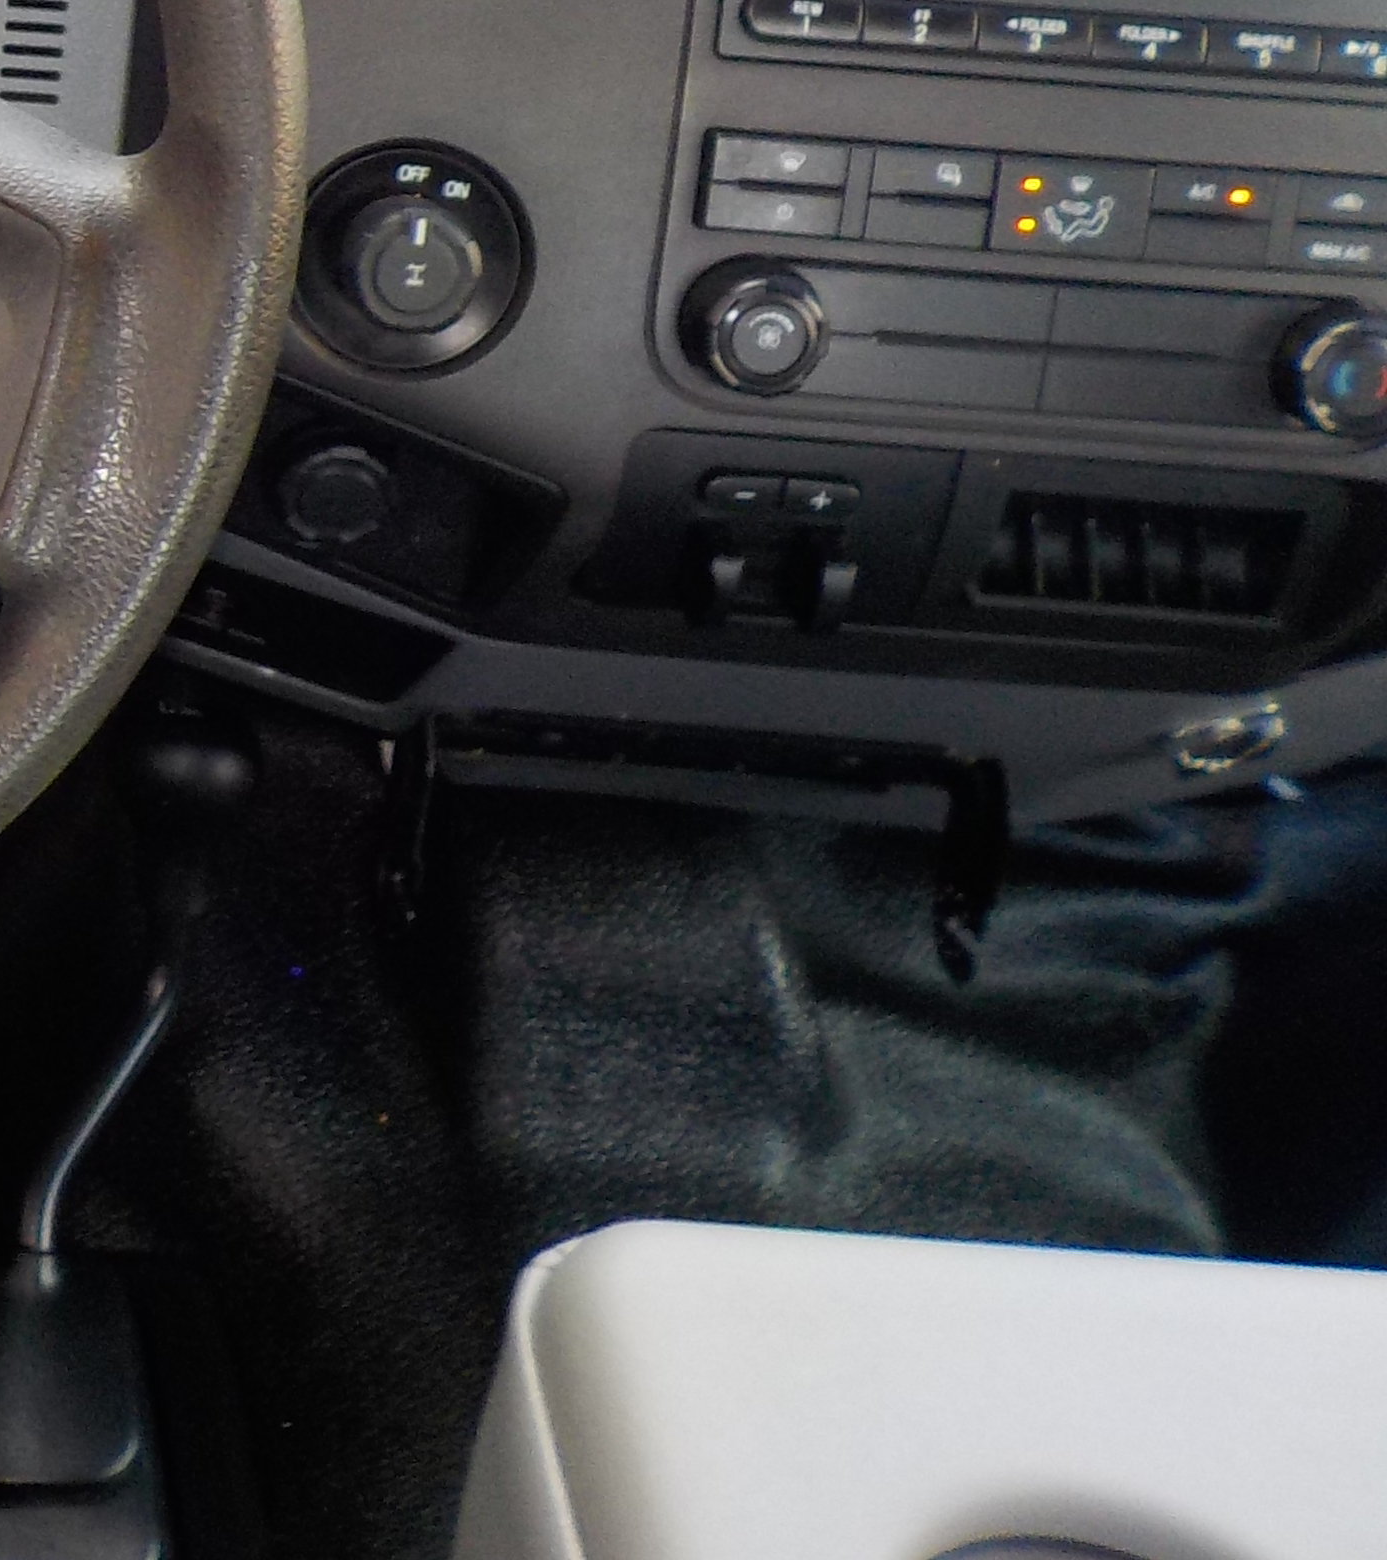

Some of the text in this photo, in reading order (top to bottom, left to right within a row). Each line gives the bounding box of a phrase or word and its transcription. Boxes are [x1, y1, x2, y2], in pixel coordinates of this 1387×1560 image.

[914, 23, 929, 44] 2
[395, 164, 431, 182] OFF
[443, 180, 471, 200] ON
